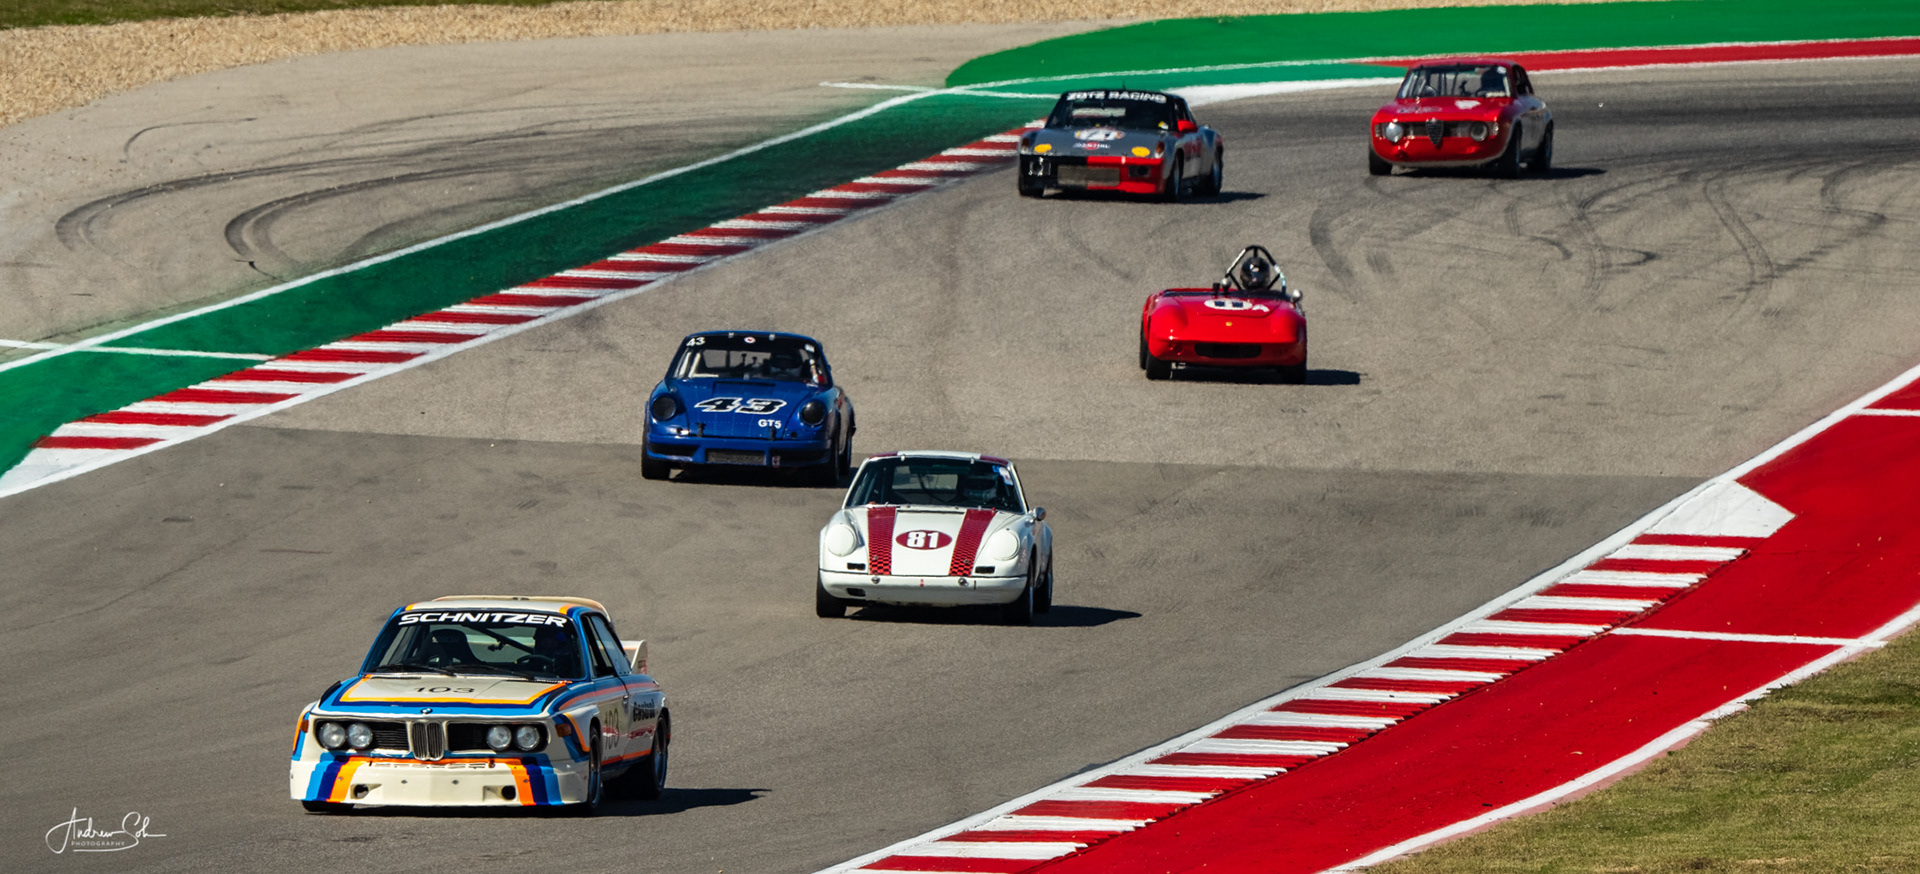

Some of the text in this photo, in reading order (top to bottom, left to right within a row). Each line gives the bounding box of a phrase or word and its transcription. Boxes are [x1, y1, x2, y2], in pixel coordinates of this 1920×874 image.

[1066, 91, 1167, 104] ZOTZ RACING
[686, 336, 706, 347] 43
[693, 396, 787, 415] 43
[758, 418, 782, 429] GT5
[906, 531, 940, 548] 81
[398, 611, 568, 628] SCHNITZER
[413, 686, 476, 694] 103
